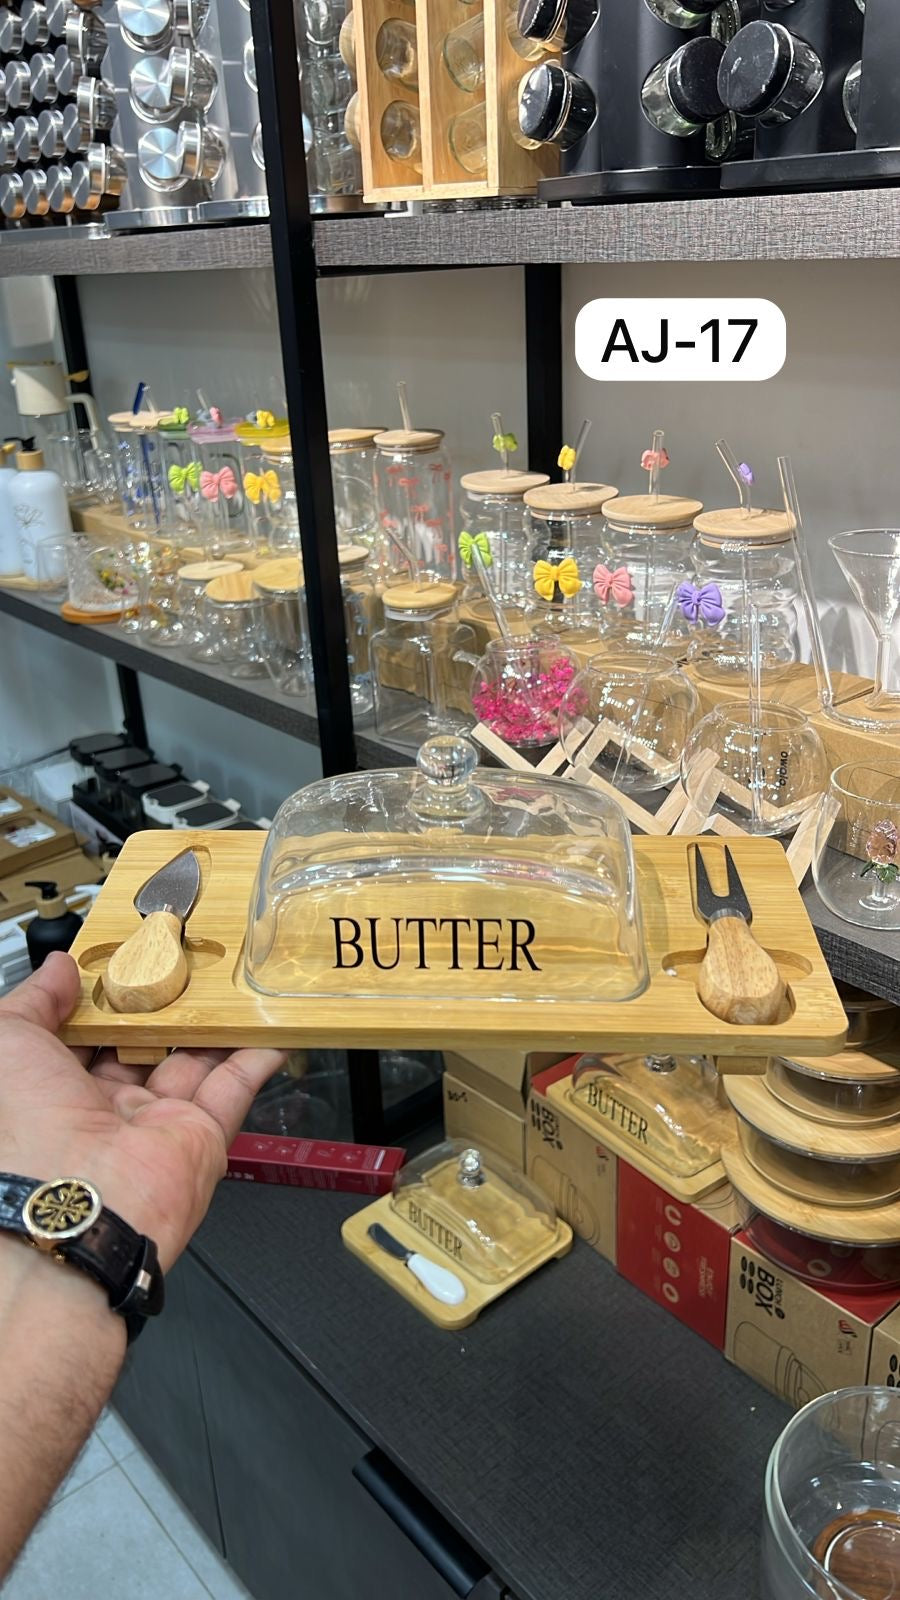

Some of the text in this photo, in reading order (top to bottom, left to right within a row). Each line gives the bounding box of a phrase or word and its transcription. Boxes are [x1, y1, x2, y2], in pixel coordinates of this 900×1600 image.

[329, 916, 542, 971] BUTTER
[586, 1081, 650, 1145] BUTTER
[408, 1200, 463, 1261] BUTTER
[754, 1266, 776, 1316] BOX
